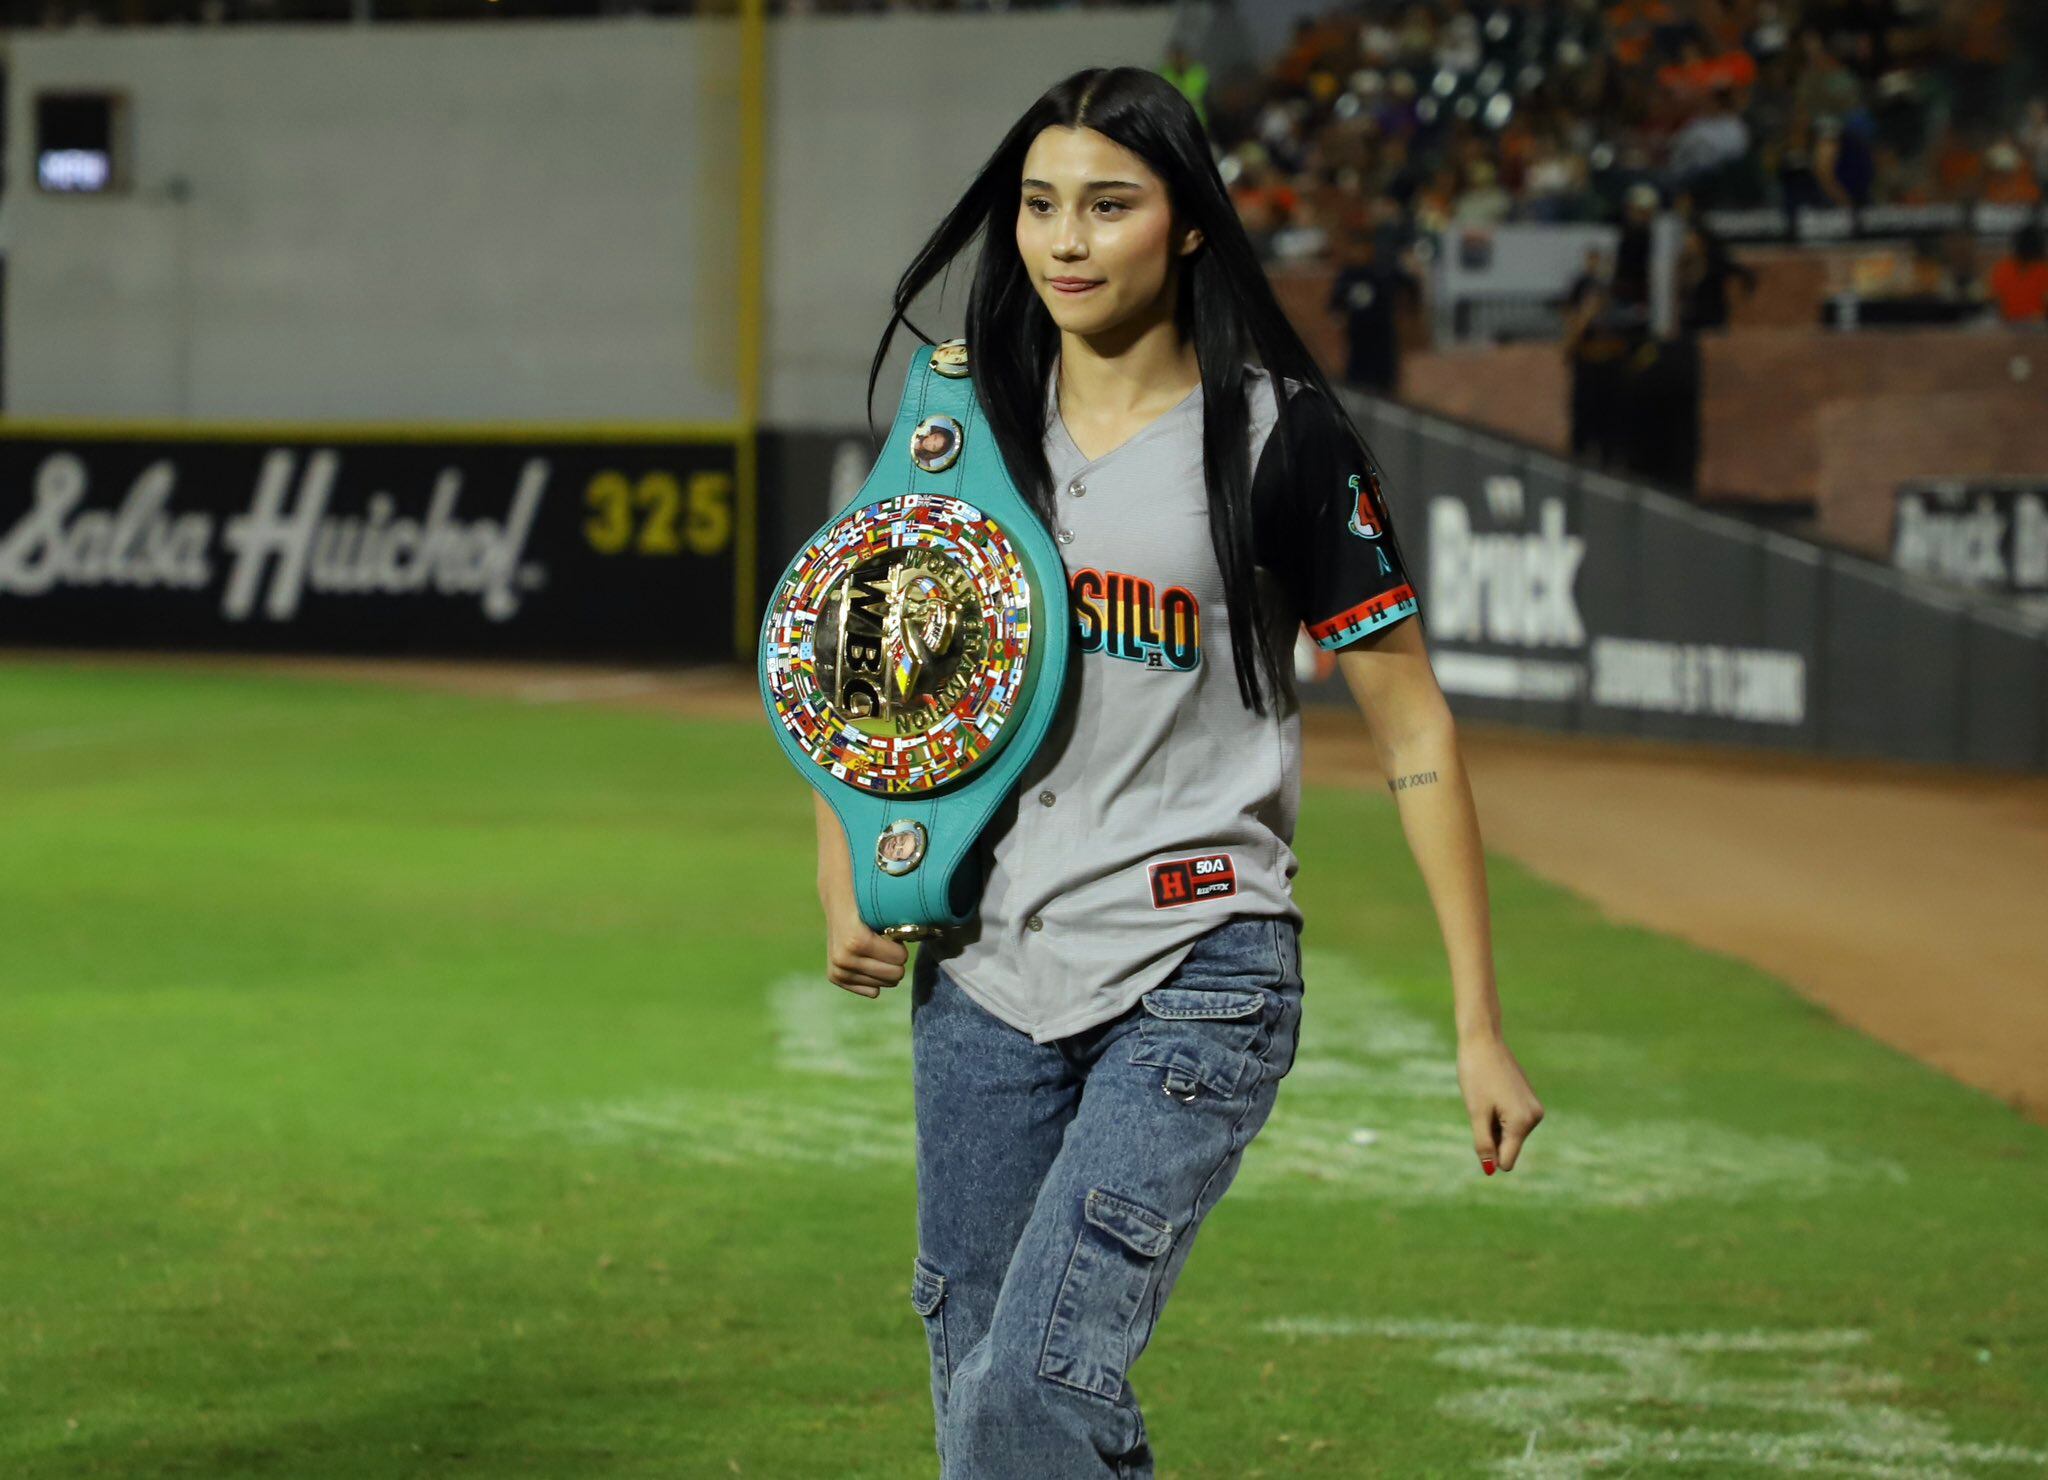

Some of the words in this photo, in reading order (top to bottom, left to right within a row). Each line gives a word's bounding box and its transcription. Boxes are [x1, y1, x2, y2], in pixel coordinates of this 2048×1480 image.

[0, 453, 211, 595] Salsa
[222, 450, 550, 620] Huichol
[585, 474, 731, 555] 325
[842, 572, 891, 717] WBC
[1160, 872, 1187, 899] H
